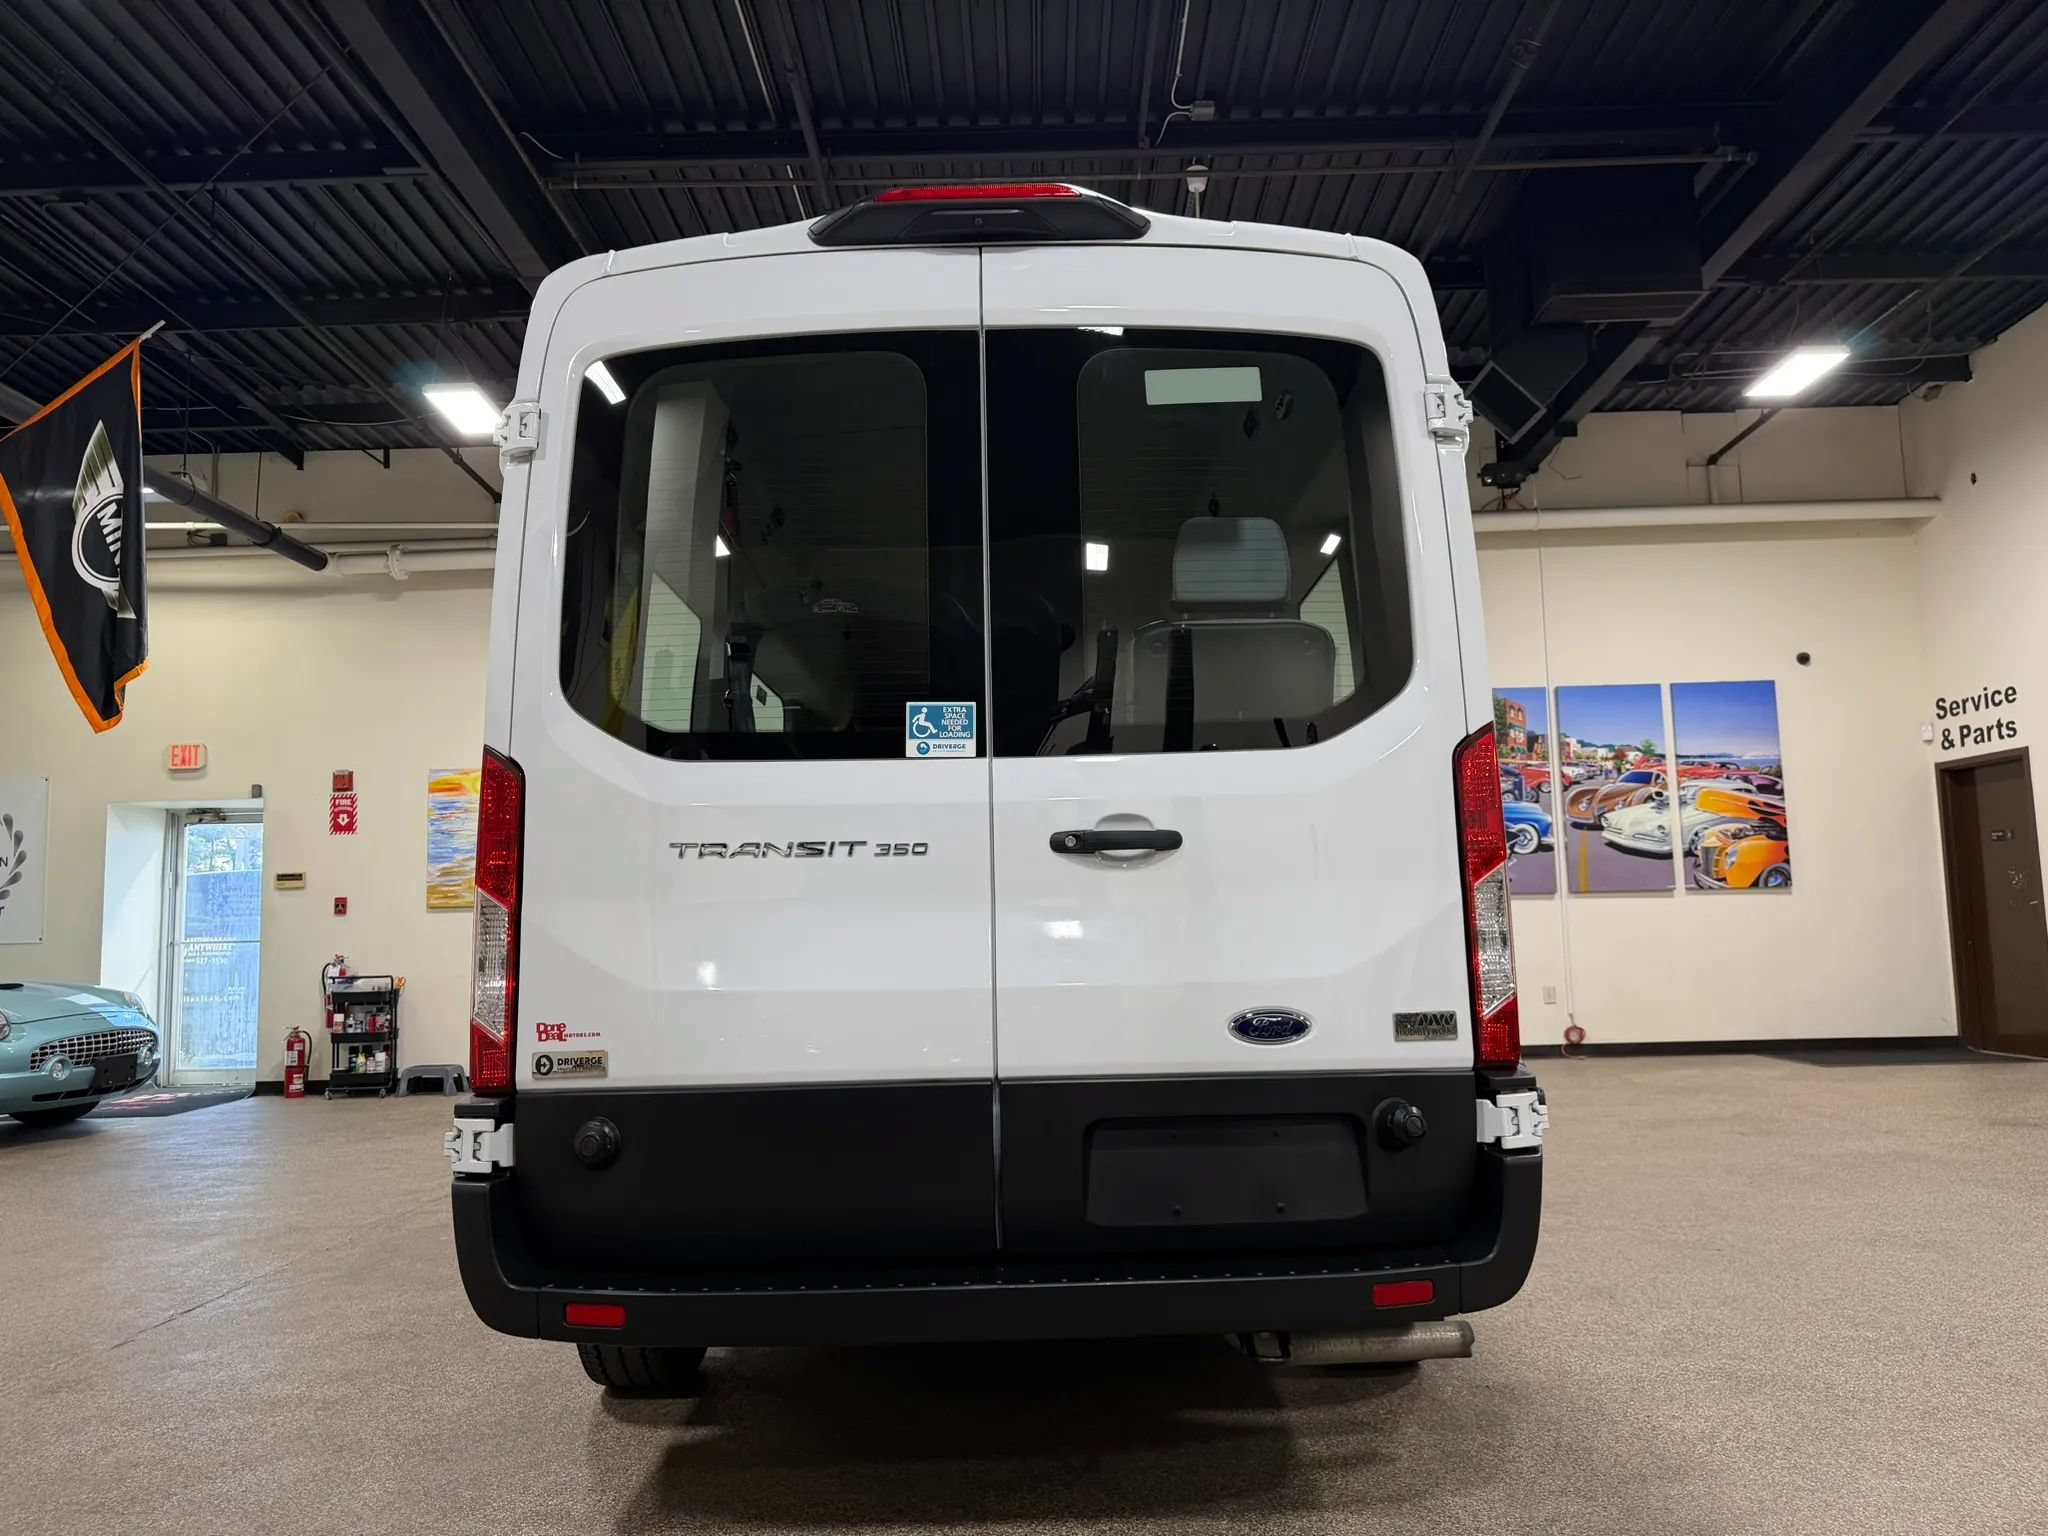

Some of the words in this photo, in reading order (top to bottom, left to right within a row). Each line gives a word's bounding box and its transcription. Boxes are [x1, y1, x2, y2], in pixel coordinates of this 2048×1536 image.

[1935, 686, 2017, 720] Service
[1941, 728, 1955, 750] &
[1959, 717, 2018, 747] Parts
[171, 744, 201, 768] EXIT
[668, 840, 868, 859] TRANSIT
[873, 842, 929, 857] 350
[536, 1022, 567, 1033] Done
[1248, 1016, 1294, 1036] Ford
[557, 1056, 603, 1066] DRIVERGE
